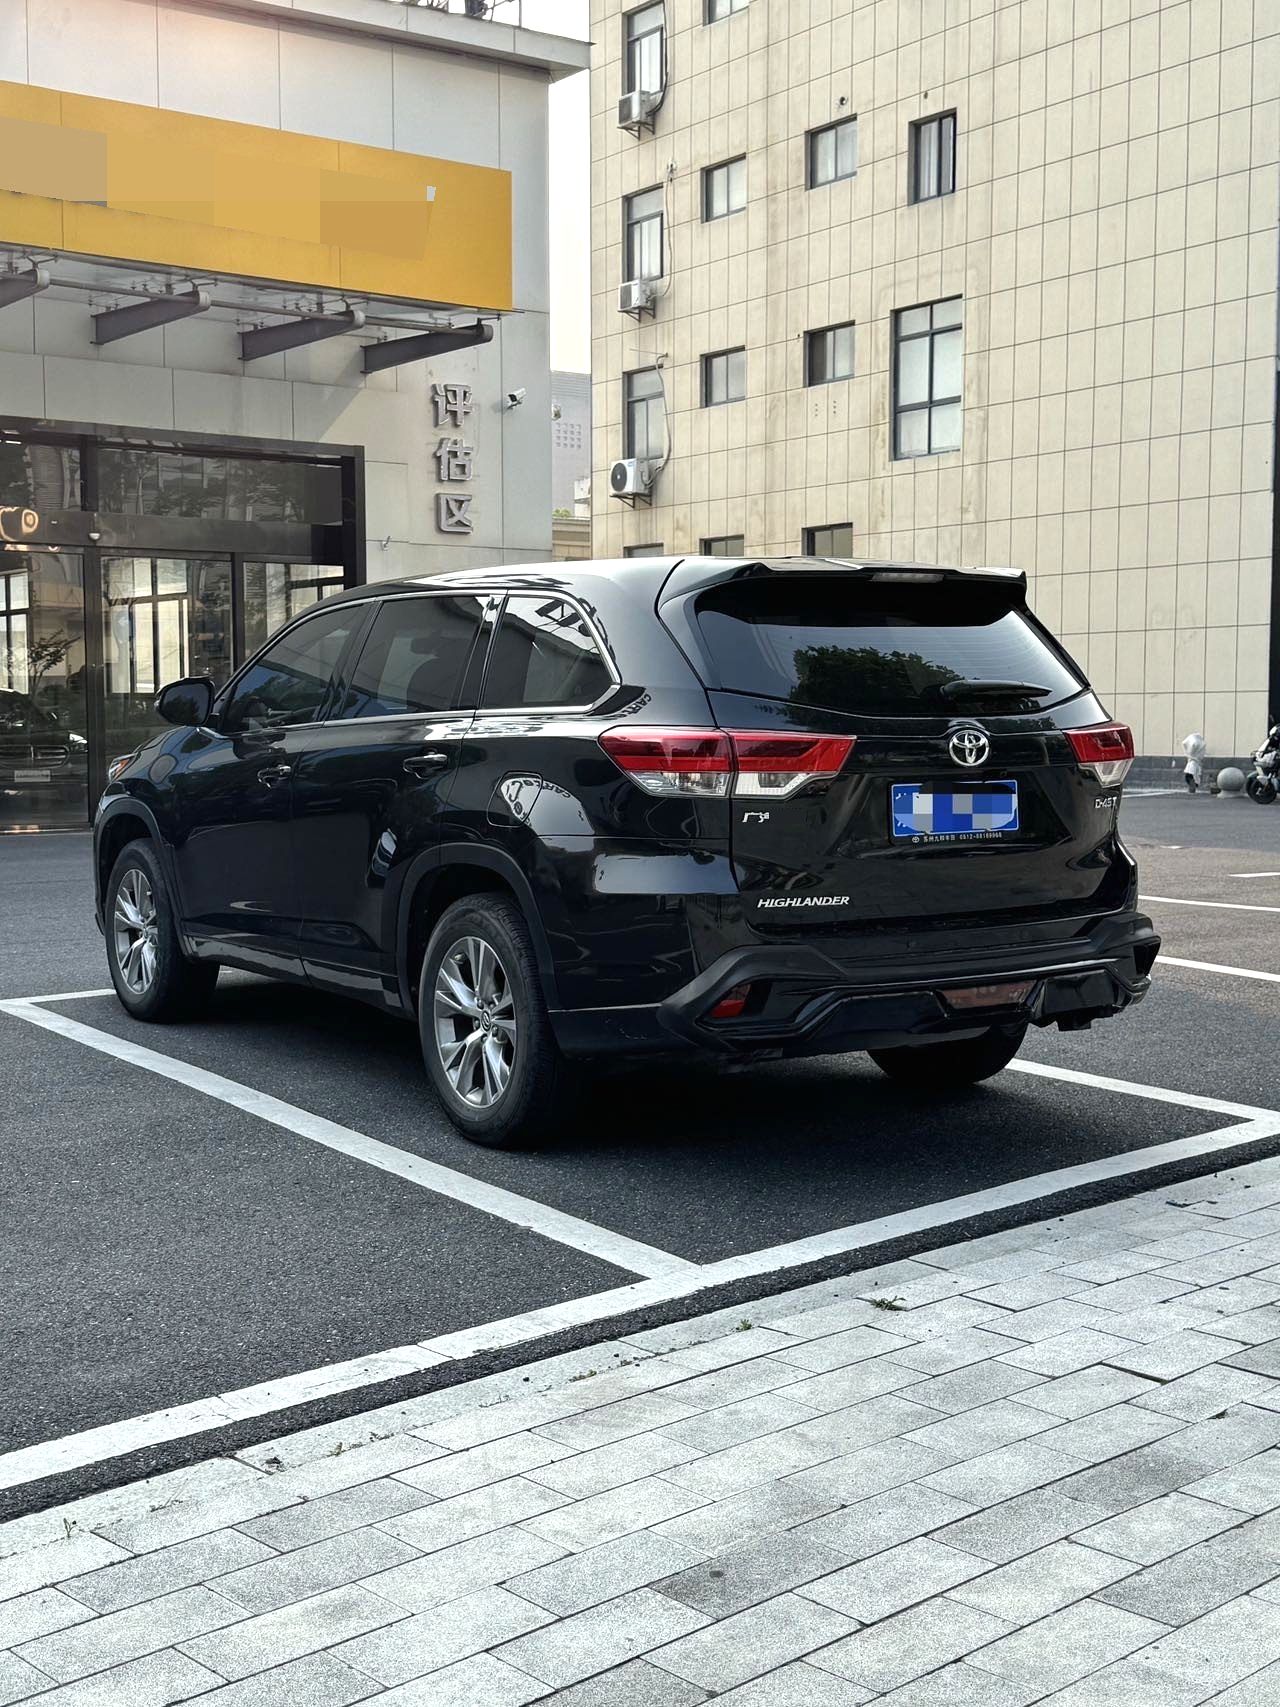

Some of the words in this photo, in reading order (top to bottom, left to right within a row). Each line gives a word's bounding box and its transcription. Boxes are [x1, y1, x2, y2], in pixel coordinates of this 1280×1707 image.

[432, 383, 474, 534] 评估区
[757, 896, 850, 908] HIGHLANDER
